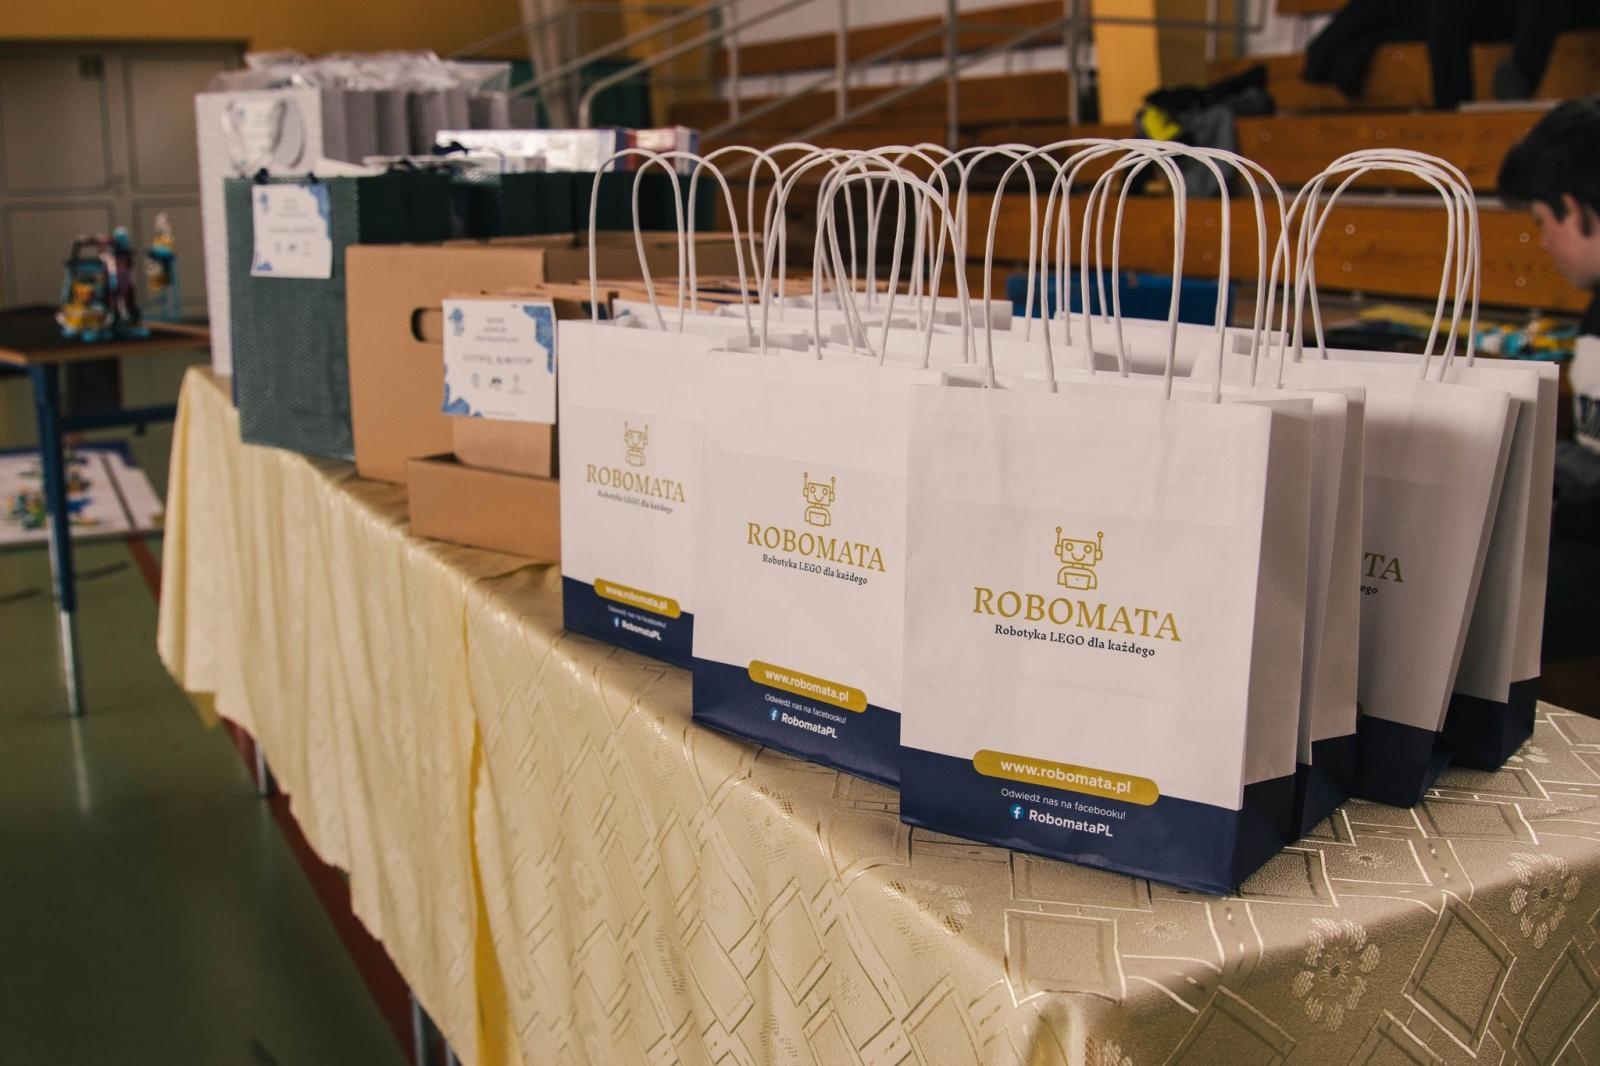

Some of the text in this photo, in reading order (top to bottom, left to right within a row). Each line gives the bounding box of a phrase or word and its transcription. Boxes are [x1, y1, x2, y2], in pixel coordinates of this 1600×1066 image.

[586, 463, 685, 503] ROBOMATA
[747, 522, 886, 572] ROBOMATA
[763, 554, 868, 586] Robotyka LEGO dla każdego
[972, 587, 1182, 642] ROBOMATA
[995, 624, 1155, 658] Robotyka LEGO dla każdego
[764, 670, 849, 702] www.robomata.pl
[781, 712, 838, 739] RobomataPL
[792, 701, 803, 711] nas
[803, 706, 812, 714] na
[812, 706, 847, 724] facebooku!
[1001, 760, 1131, 794] www.robomata.pl
[1001, 788, 1126, 820] Odwiedź nas na facebooku!
[1029, 809, 1113, 837] RobomataPL
